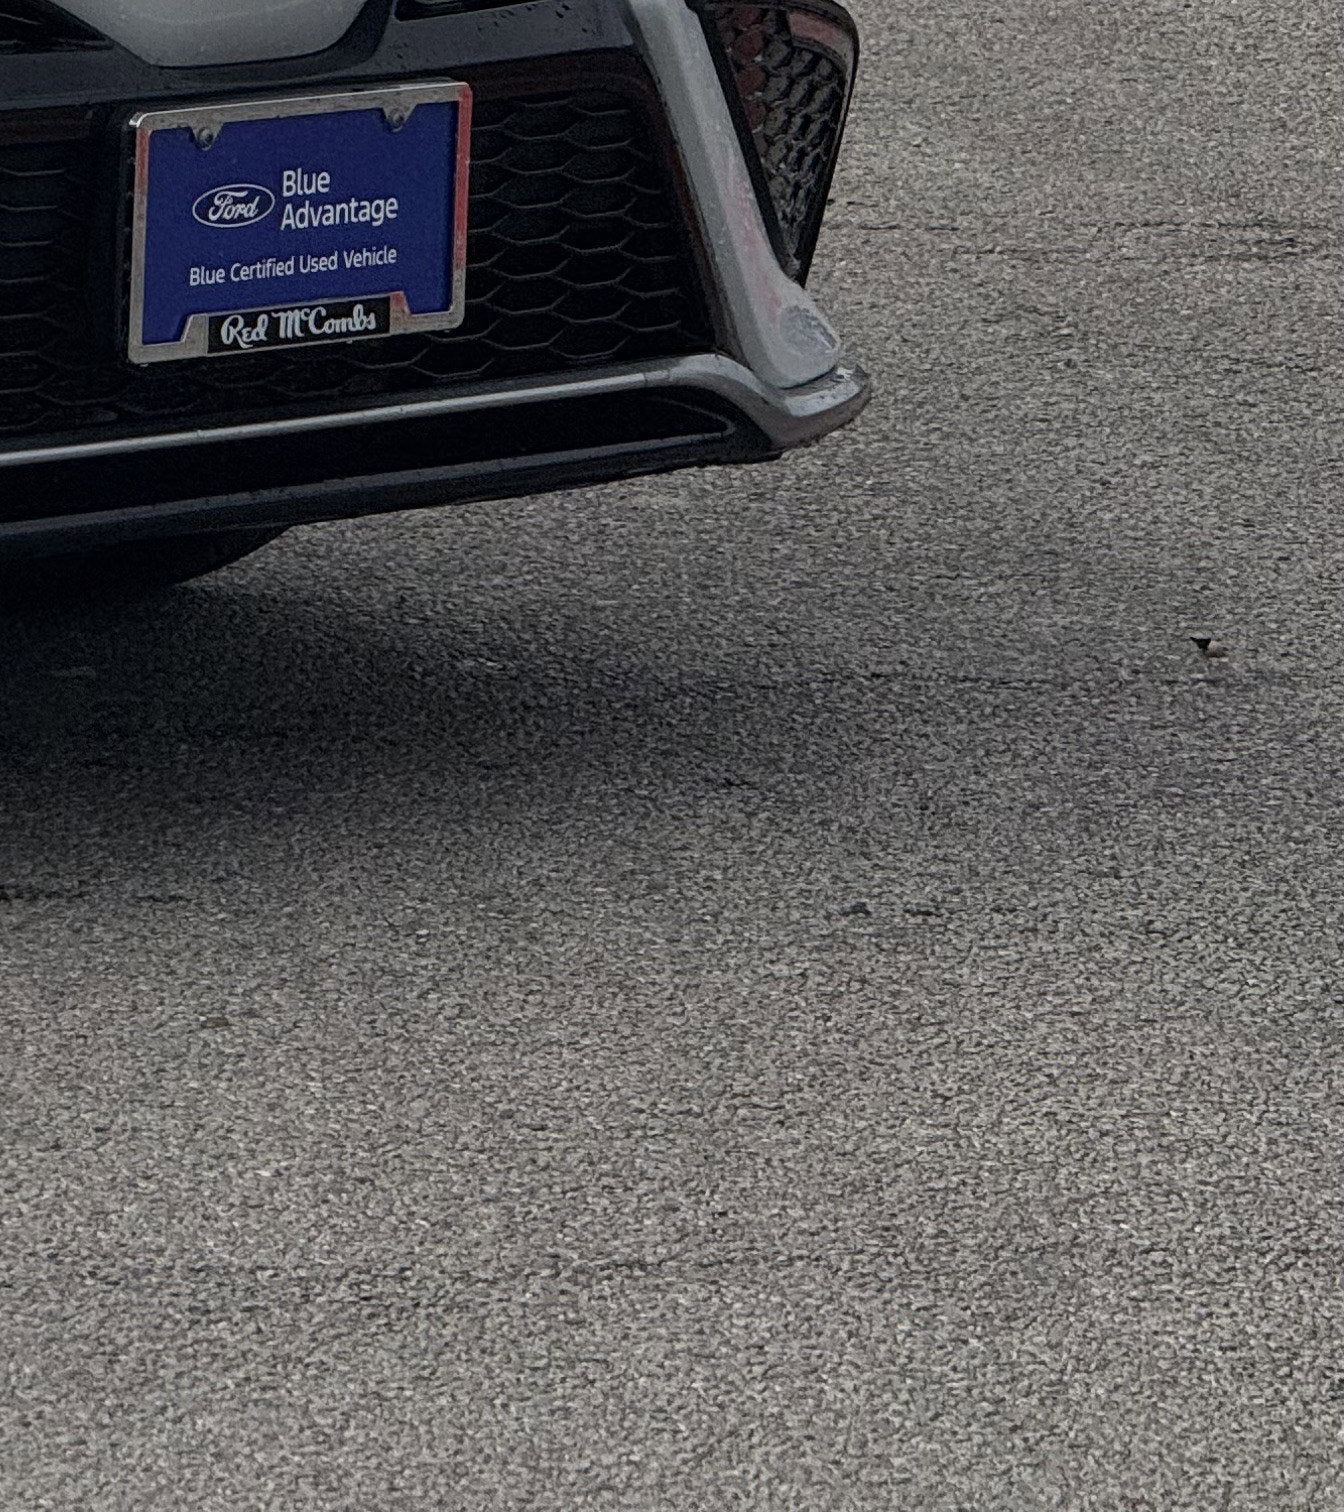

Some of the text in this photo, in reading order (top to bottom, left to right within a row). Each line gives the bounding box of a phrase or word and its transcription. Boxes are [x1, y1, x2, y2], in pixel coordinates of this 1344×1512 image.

[282, 168, 330, 197] Blue
[208, 190, 260, 221] Ford
[280, 195, 399, 231] Advantage
[189, 245, 397, 287] Blue Certified Used Vehicle
[220, 314, 267, 349] Red
